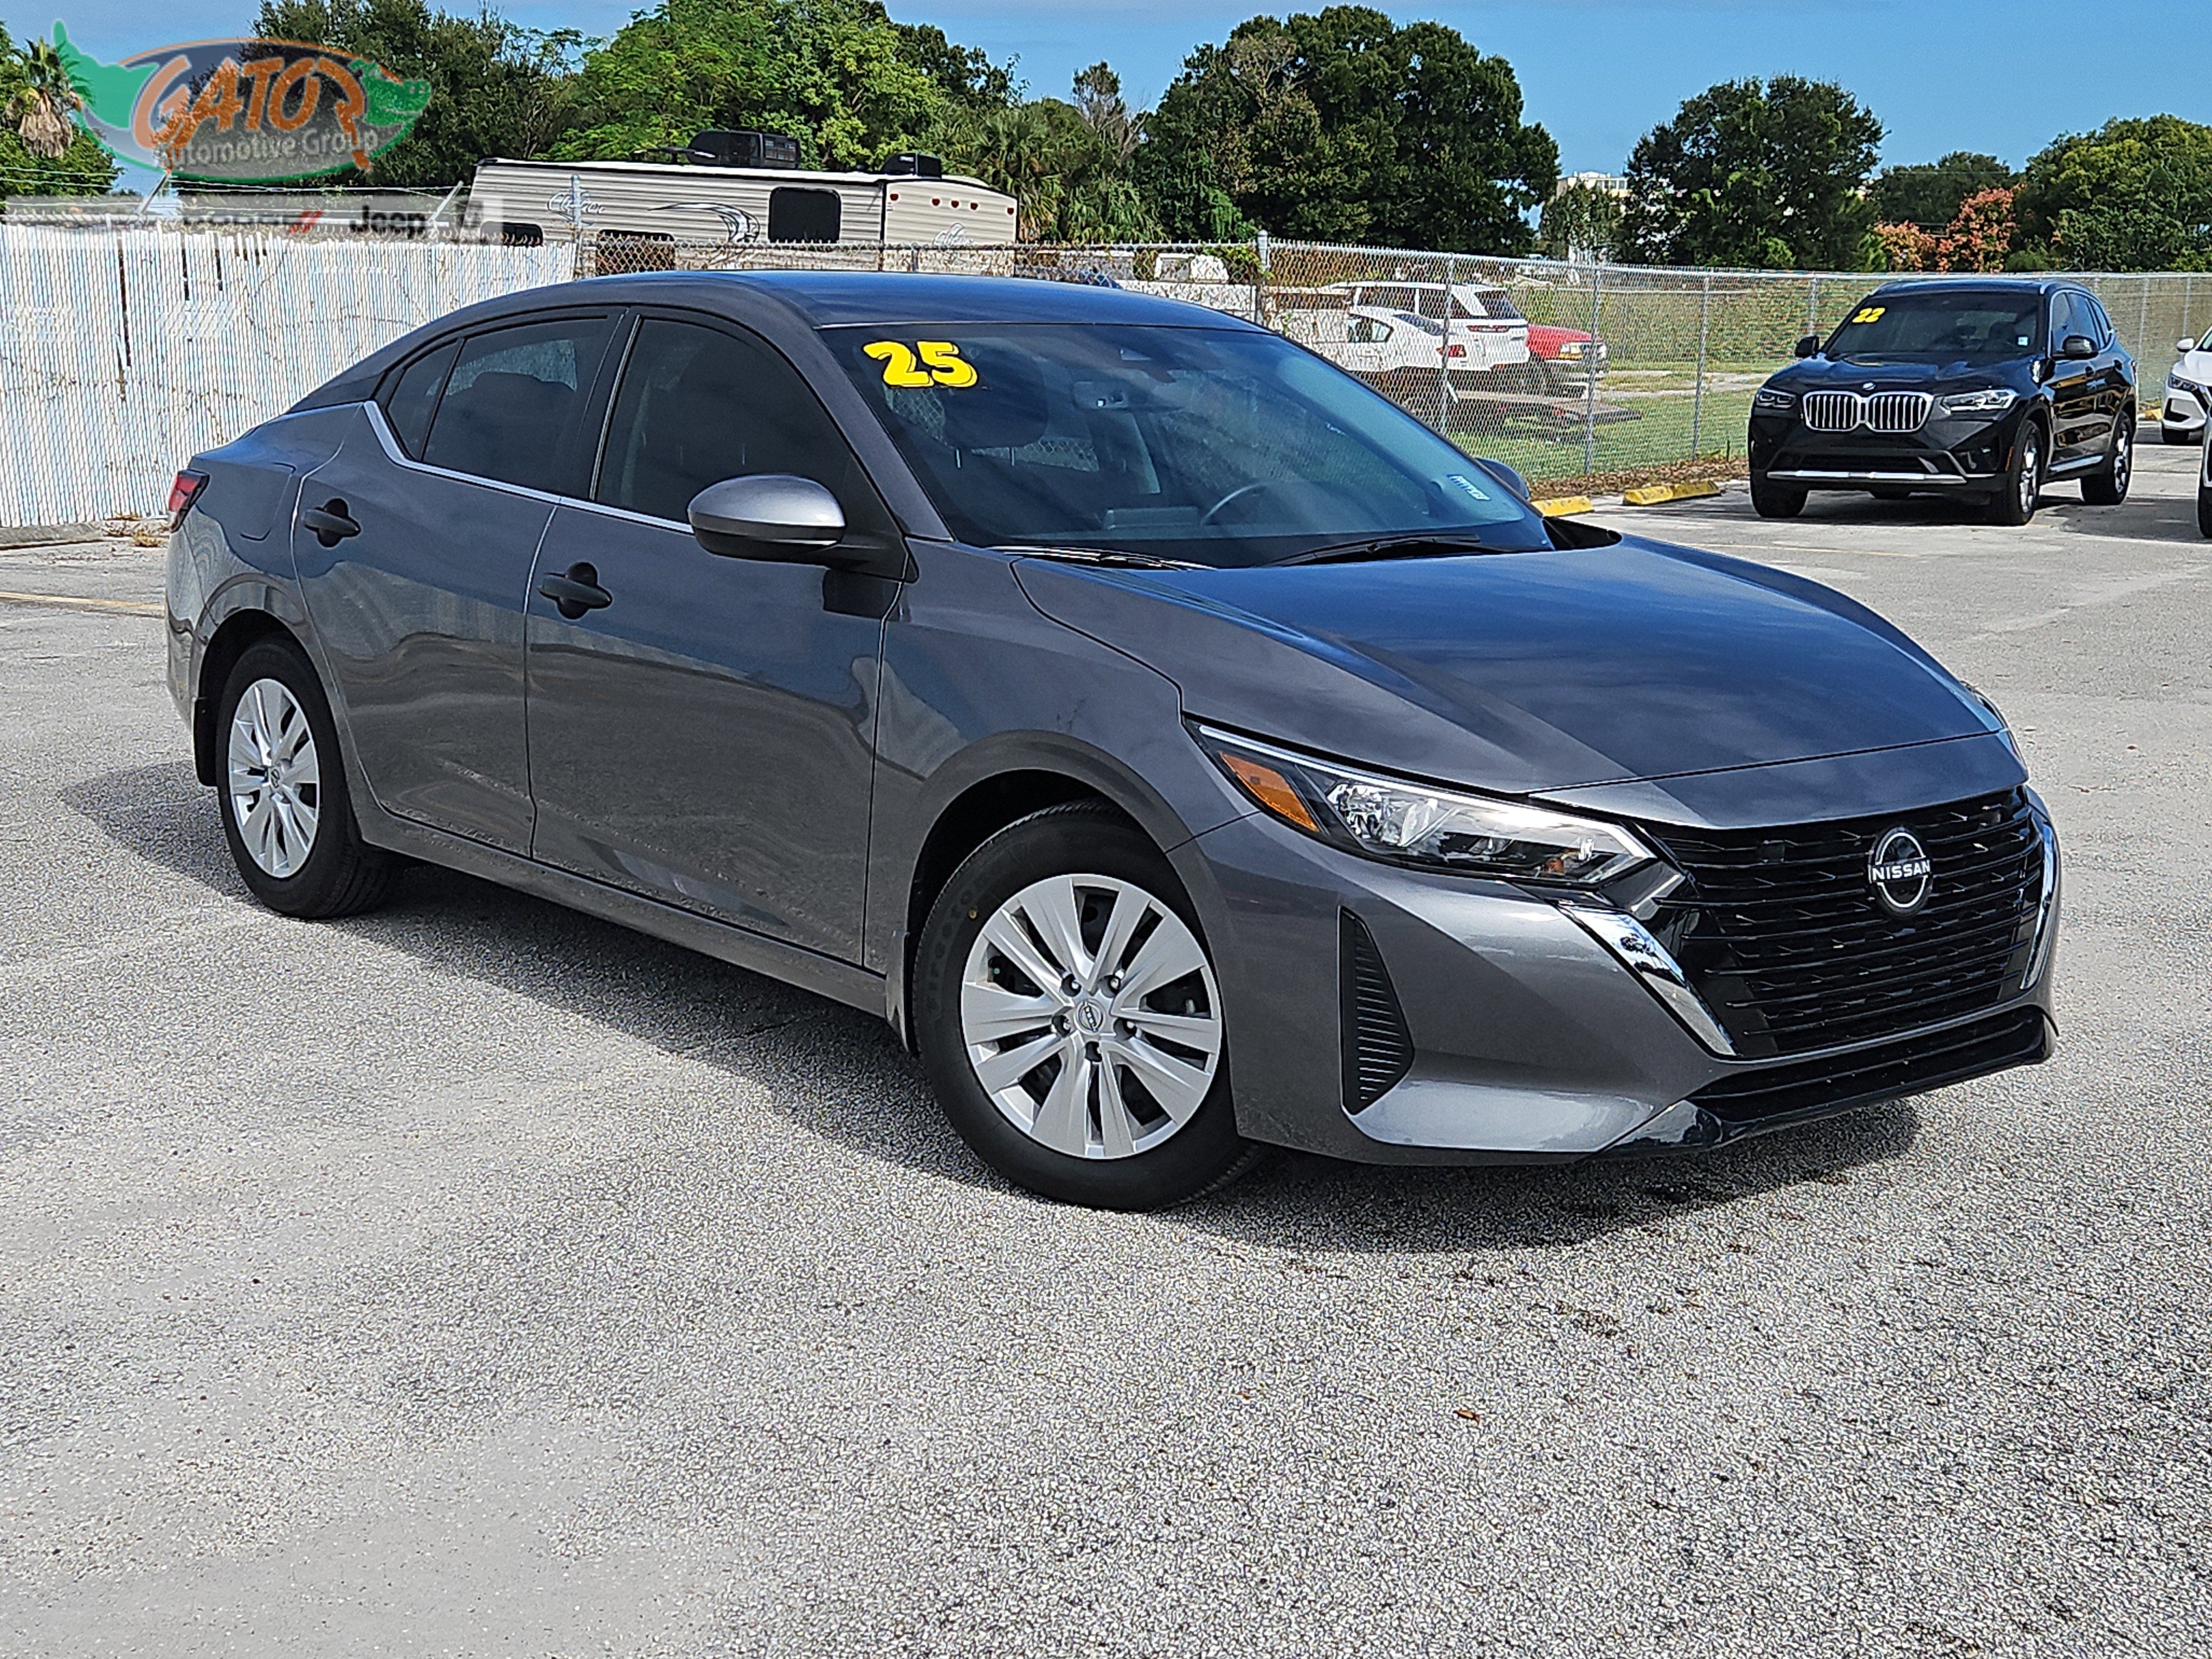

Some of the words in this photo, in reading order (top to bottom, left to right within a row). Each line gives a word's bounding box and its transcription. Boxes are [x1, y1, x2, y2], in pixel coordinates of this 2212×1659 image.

[1851, 307, 1886, 324] 22
[861, 340, 979, 389] 25
[1872, 859, 1931, 880] NISSAN
